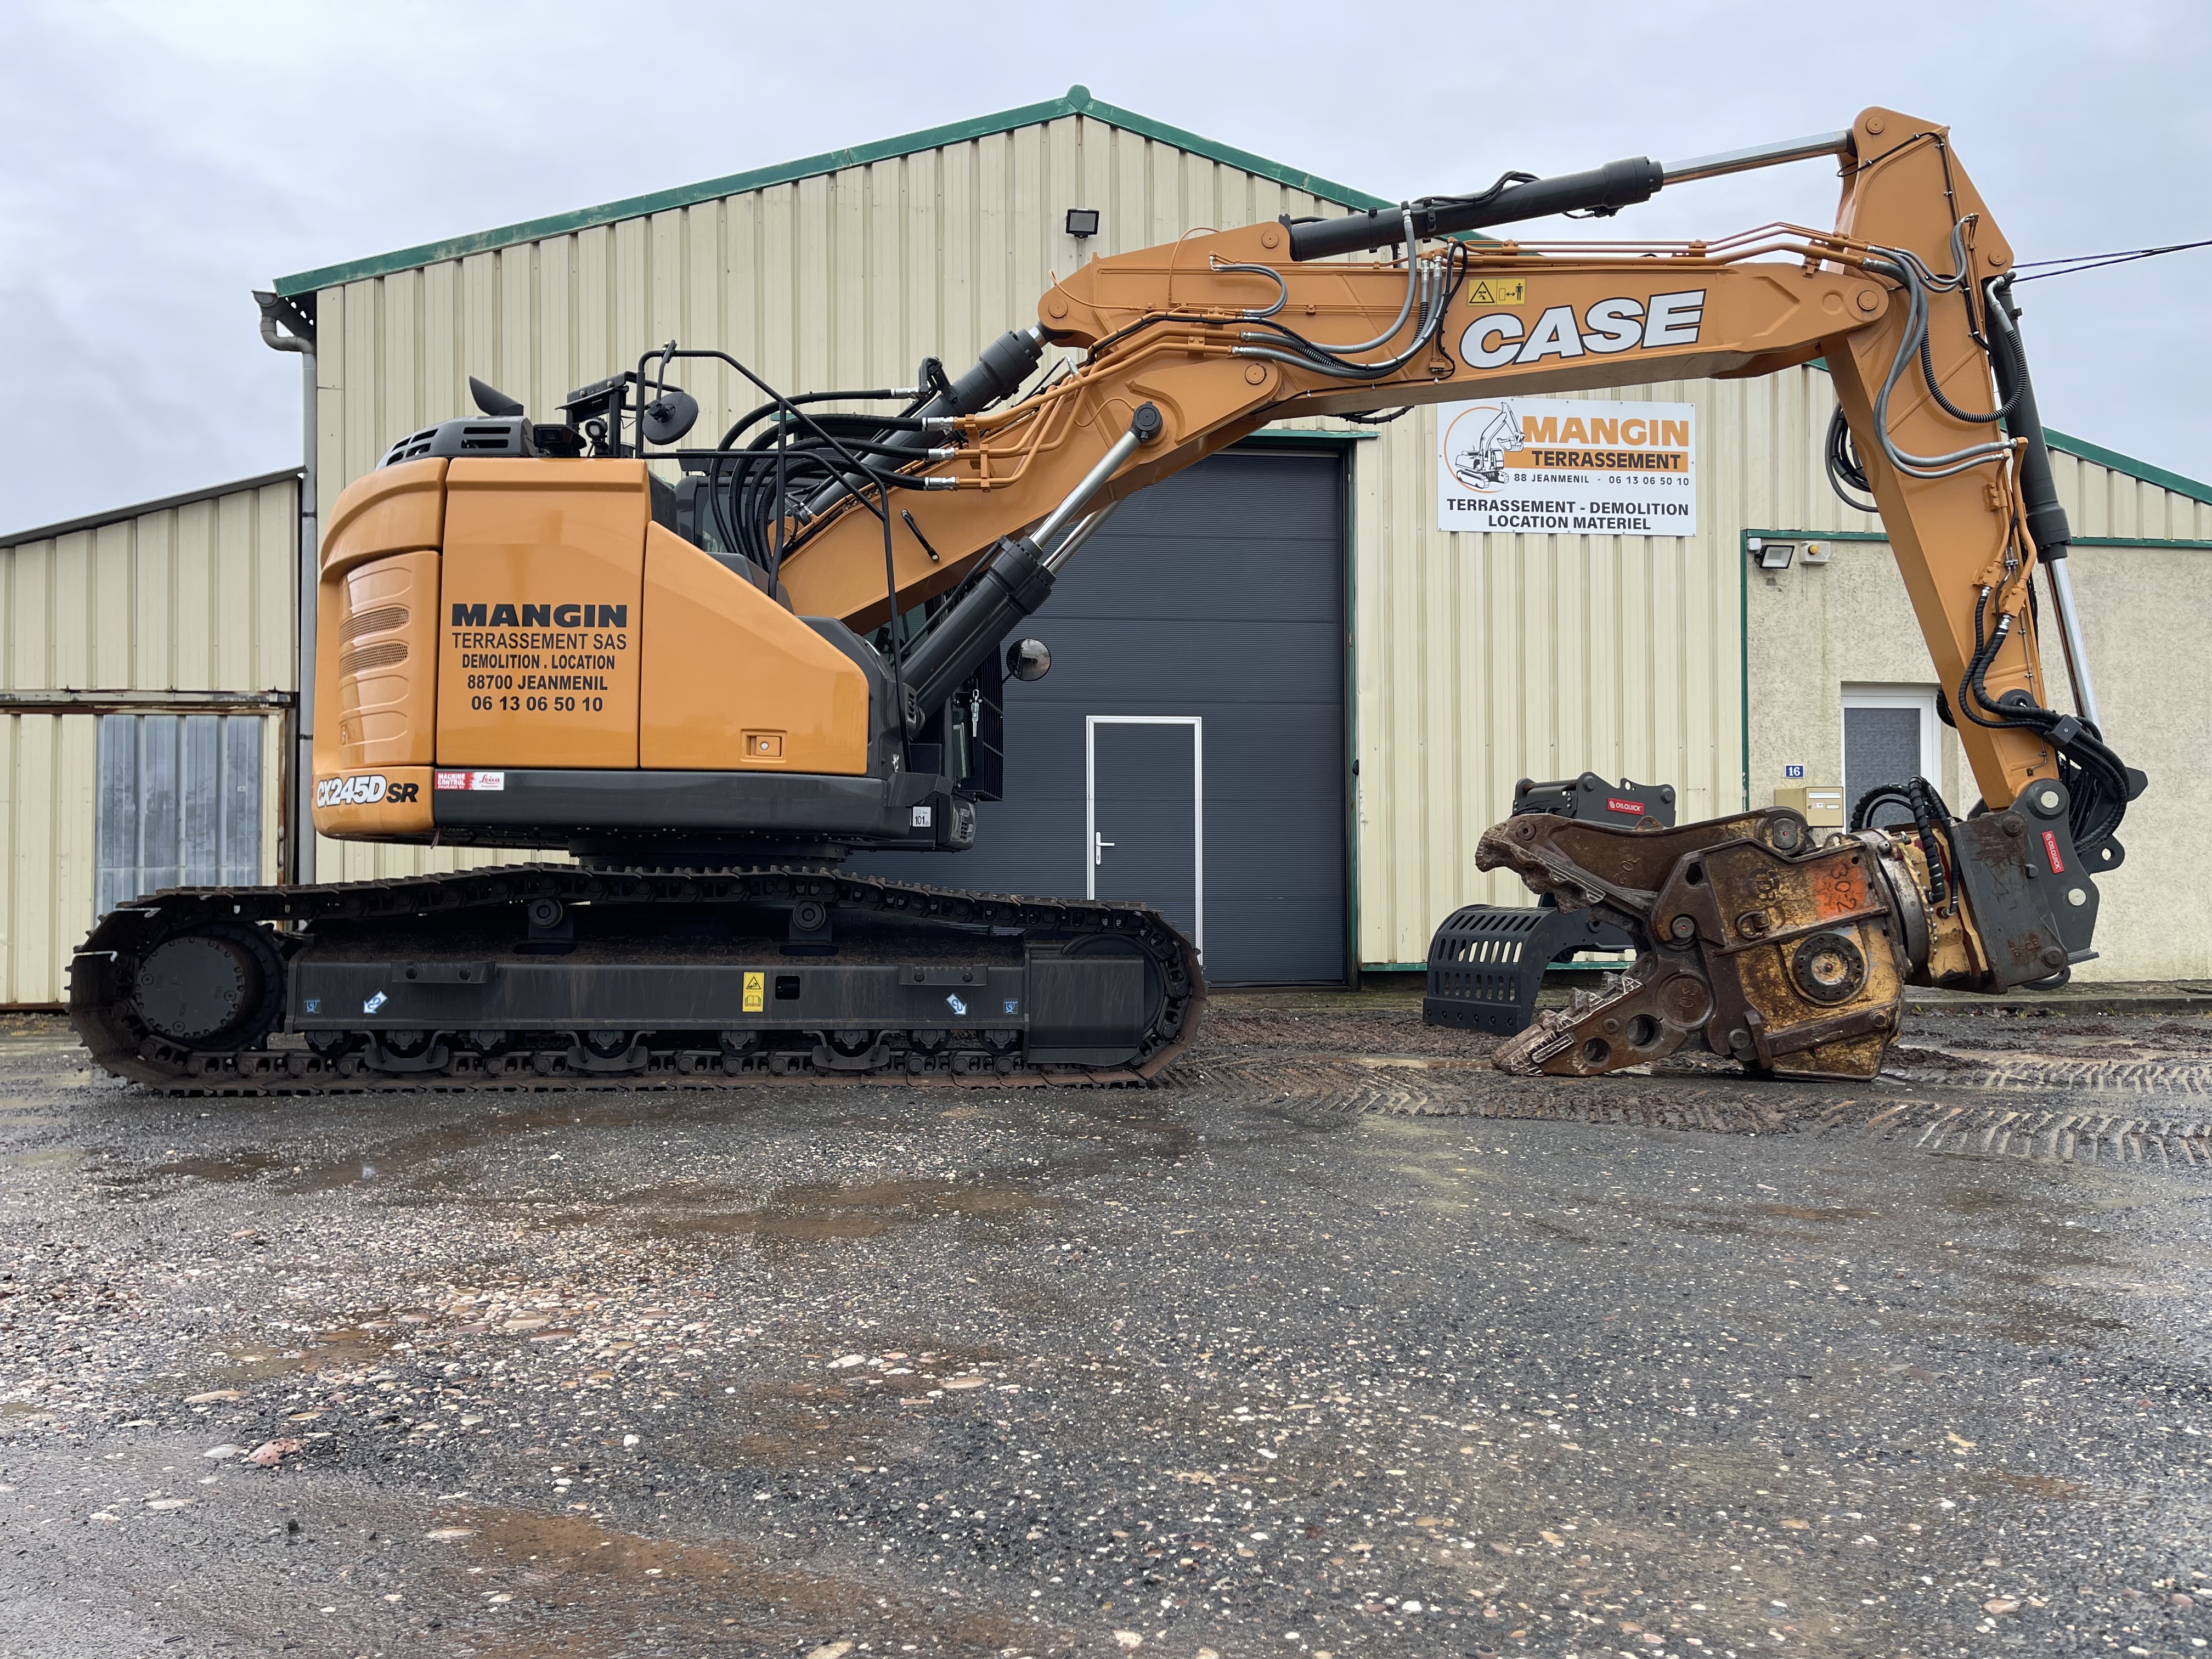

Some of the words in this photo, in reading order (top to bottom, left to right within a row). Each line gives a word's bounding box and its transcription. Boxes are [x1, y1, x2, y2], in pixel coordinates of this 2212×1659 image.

[1460, 289, 1707, 369] CASE
[1522, 416, 1689, 447] MANGIN
[1532, 450, 1681, 470] TERRASSEMENT
[1514, 473, 1527, 482] 88
[1531, 474, 1589, 483] JEANMENIL
[1609, 476, 1621, 484] 06
[1626, 476, 1638, 484] 13
[1643, 477, 1655, 485] 06
[1660, 477, 1672, 485] 50
[1677, 477, 1689, 486] 10
[1447, 499, 1576, 514] TERRASSEMENT
[1590, 501, 1689, 516] DEMOLITION
[1488, 515, 1568, 528] LOCATION
[1573, 517, 1651, 530] MATERIEL
[452, 603, 627, 628] MANGIN
[452, 632, 588, 650] TERRASSEMENT
[593, 633, 627, 650] SAS
[462, 653, 539, 669] DEMOLITION
[551, 654, 615, 670] LOCATION
[467, 674, 512, 690] 88700
[517, 675, 608, 691] JEANMENIL
[471, 696, 493, 710] 06
[499, 696, 520, 711] 13
[526, 696, 548, 711] 06
[554, 696, 575, 712] 50
[582, 697, 603, 712] 10
[479, 774, 500, 783] Leica
[1788, 766, 1801, 776] 16
[317, 774, 387, 808] CX245D
[387, 783, 419, 803] SR
[1616, 803, 1641, 811] OILQUICK
[915, 815, 925, 825] 101
[2048, 840, 2061, 870] OILQUICK
